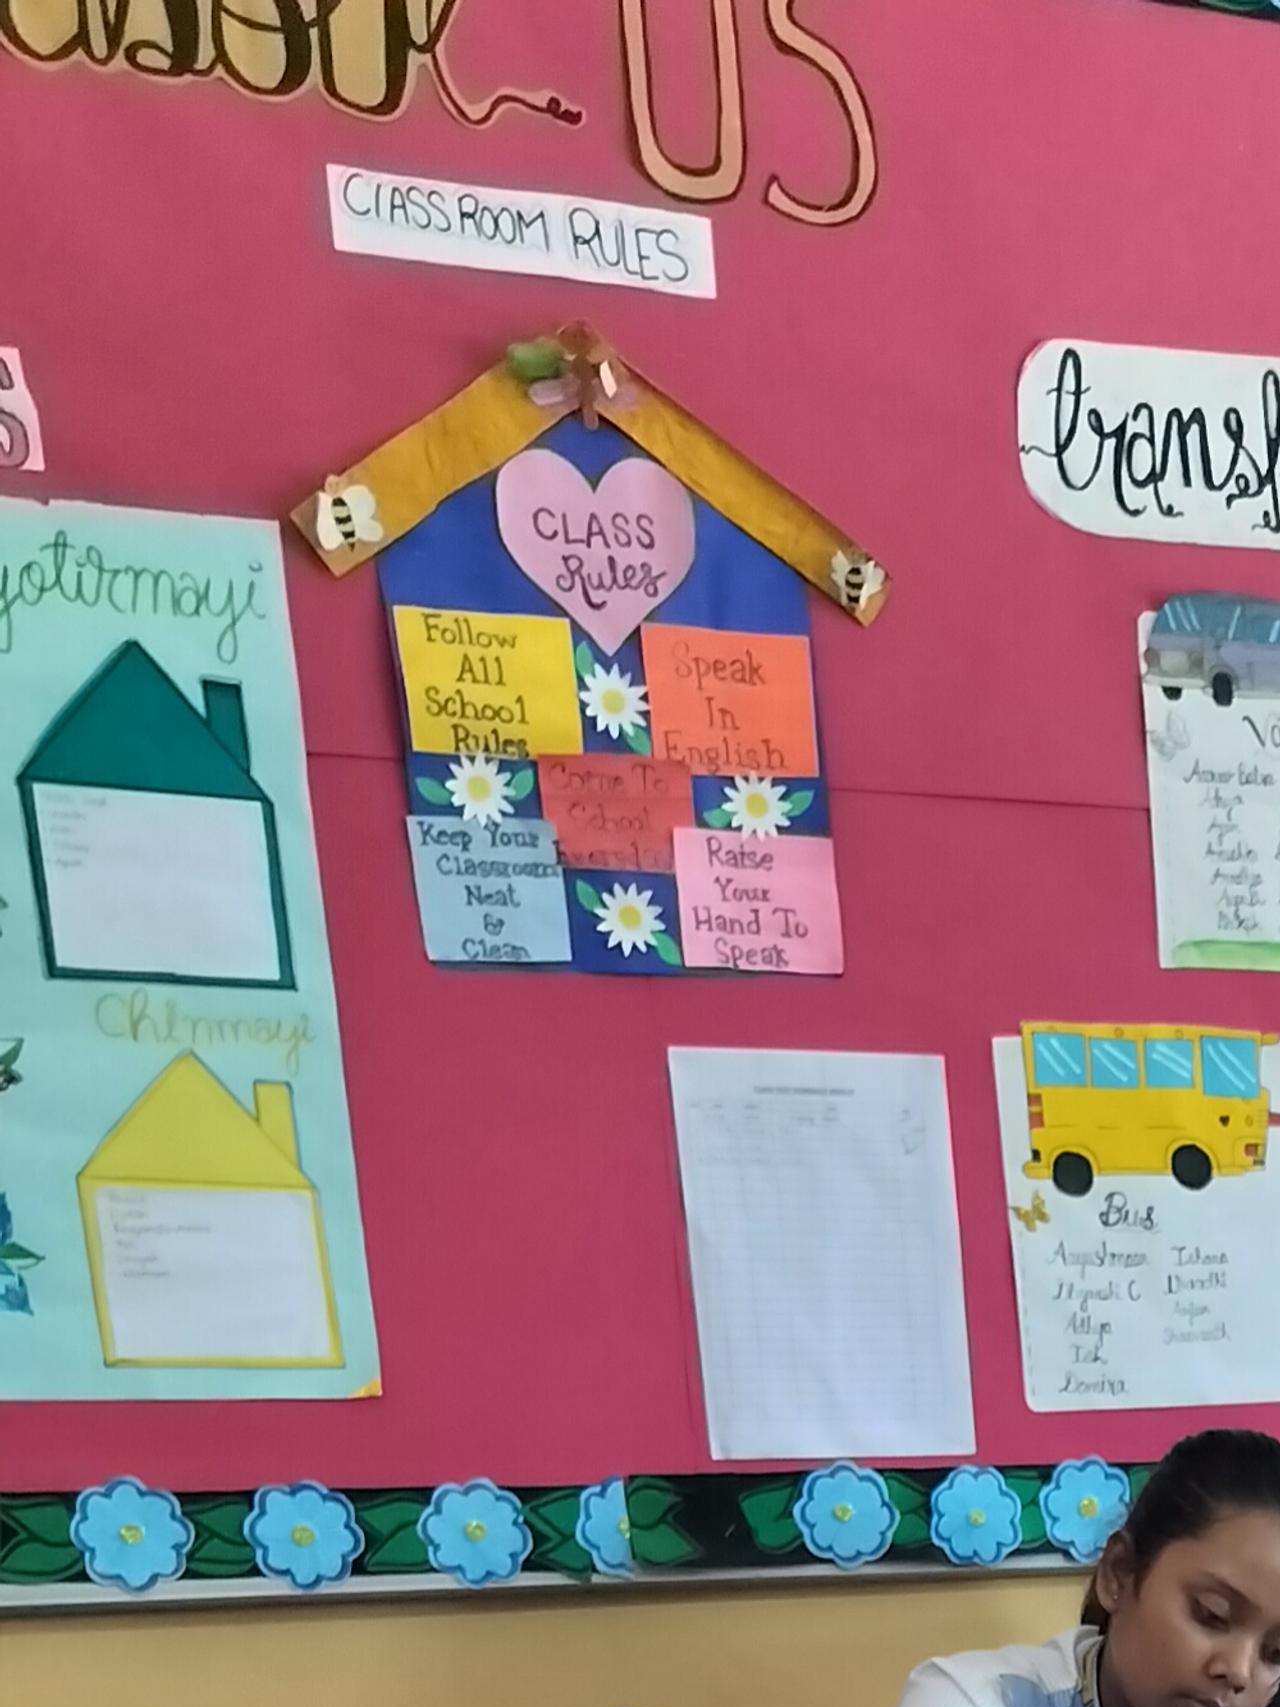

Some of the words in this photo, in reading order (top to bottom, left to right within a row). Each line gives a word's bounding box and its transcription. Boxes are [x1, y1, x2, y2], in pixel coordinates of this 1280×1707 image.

[570, 207, 691, 283] RULES
[532, 508, 655, 552] CLASS
[554, 554, 668, 610] Rules
[421, 613, 518, 651] Follow
[456, 654, 507, 686] All
[673, 641, 766, 690] Speak
[425, 686, 529, 725] School
[705, 699, 739, 731] In
[451, 724, 529, 758] Rules
[663, 730, 789, 774] English
[634, 764, 669, 793] To
[416, 820, 472, 852] Keep
[484, 820, 539, 848] Your
[436, 854, 561, 878] Classroom
[706, 837, 774, 871] Raise
[465, 885, 521, 907] Neat
[714, 877, 772, 902] Your
[693, 906, 761, 937] Hand
[772, 908, 808, 938] To
[462, 938, 531, 960] Clean
[715, 937, 790, 968] Speak
[1099, 1191, 1158, 1231] Bus
